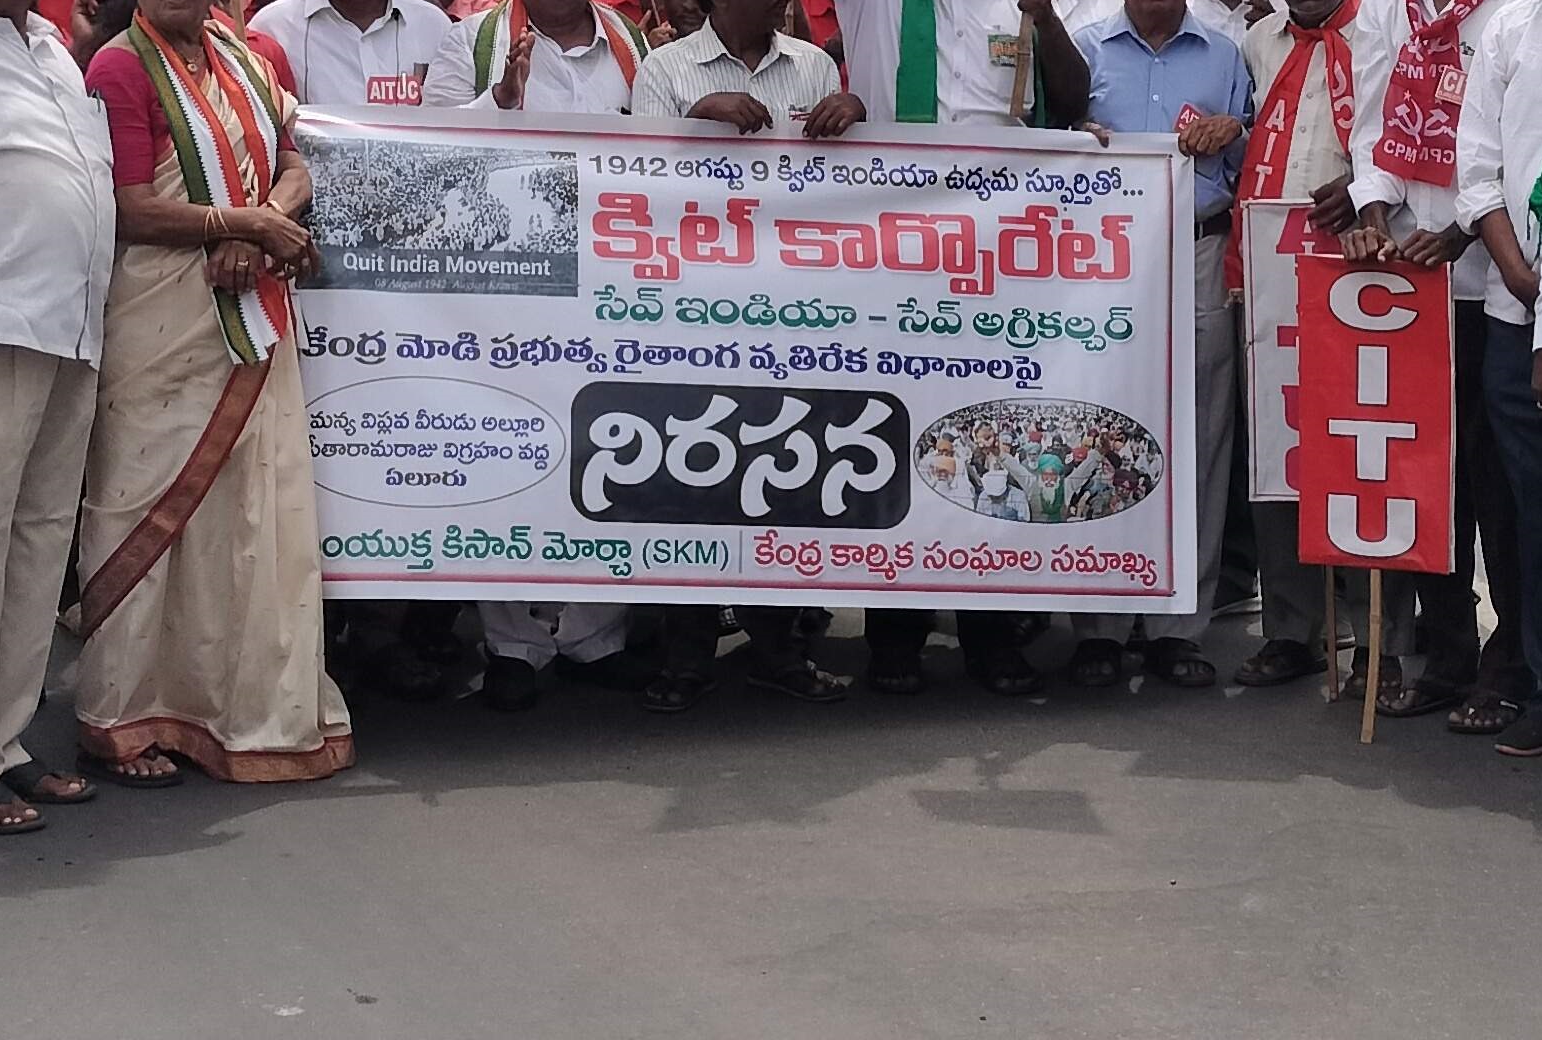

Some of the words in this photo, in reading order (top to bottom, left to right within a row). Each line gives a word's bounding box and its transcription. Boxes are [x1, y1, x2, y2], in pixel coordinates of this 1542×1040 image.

[370, 81, 419, 100] AITUC
[590, 155, 668, 177] 1942
[751, 161, 769, 181] 9
[777, 155, 826, 193] క్విట్
[832, 158, 938, 189] ఇండియా
[945, 166, 1019, 202] ఉద్యమ
[343, 253, 385, 273] Quit
[390, 254, 440, 273] India
[445, 256, 551, 276] Movement
[593, 285, 663, 324] సేవ్
[674, 292, 857, 329] ఇండియా
[896, 297, 963, 335] సేవ్
[972, 306, 1134, 352] అగ్రికల్చర్
[301, 325, 387, 365] కేంద్ర
[489, 333, 607, 374] ప్రభుత్వ
[613, 338, 740, 374] రైతాంగ
[750, 342, 868, 380] వ్యతిరేక
[876, 350, 1044, 390] విధానాలపై
[360, 412, 410, 435] విప్లవ
[414, 408, 477, 431] వీరుడు
[481, 416, 546, 438] అల్లూరి
[1328, 271, 1419, 558] CITU
[385, 467, 467, 488] ఏలూరు
[443, 440, 514, 464] విగ్రహం
[518, 443, 550, 470] వద్ద
[580, 394, 897, 518] నిరసన
[441, 524, 532, 559] కిసాన్
[541, 531, 632, 577] మోర్చా
[642, 537, 730, 572] (SKM)
[752, 529, 823, 576] కేంద్ర
[829, 541, 915, 582] కార్మిక
[922, 540, 1044, 577] సంఘాల
[1050, 543, 1158, 589] సమాఖ్య
